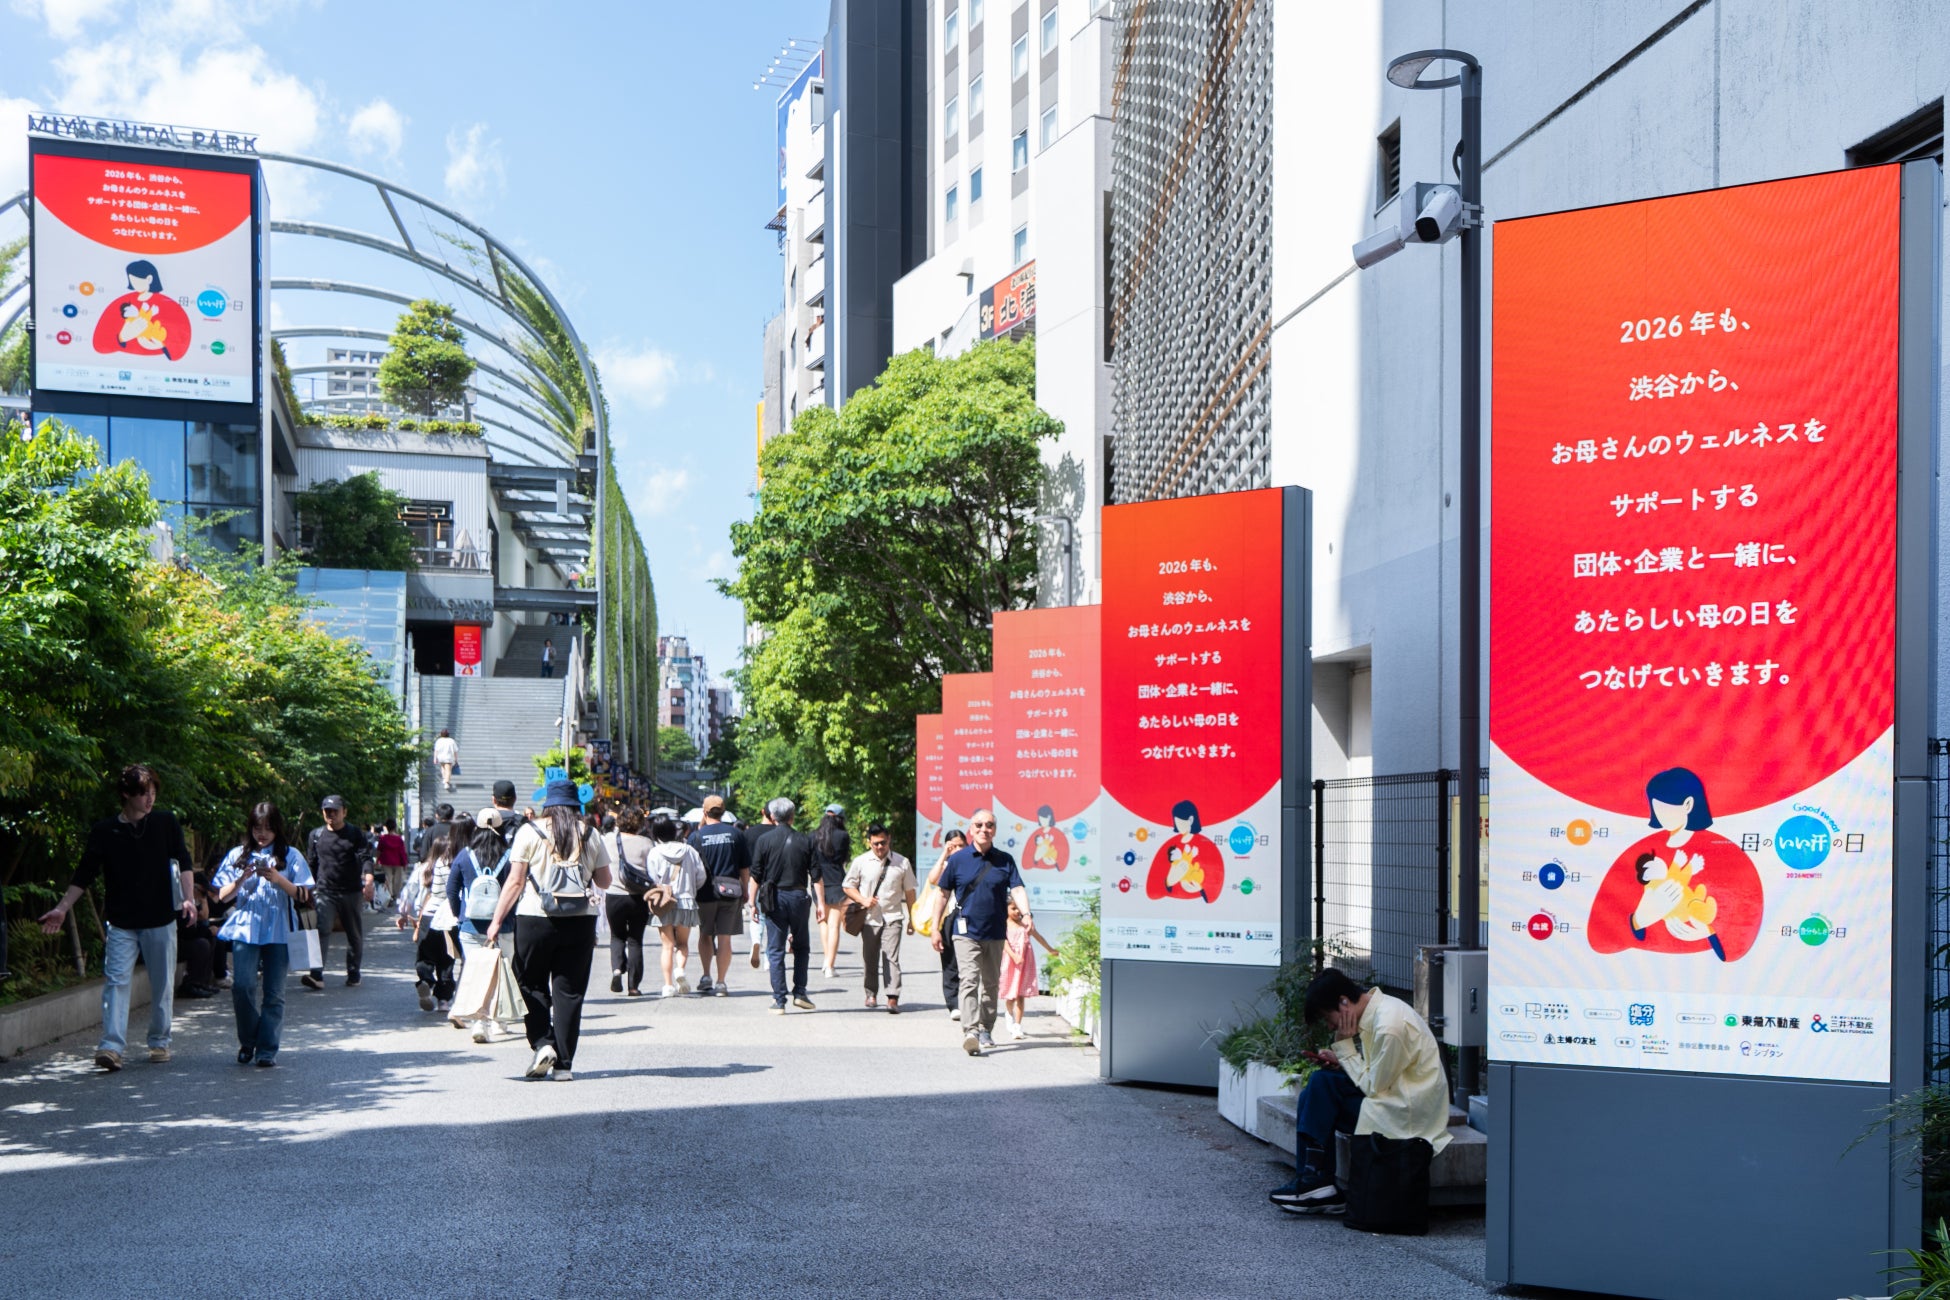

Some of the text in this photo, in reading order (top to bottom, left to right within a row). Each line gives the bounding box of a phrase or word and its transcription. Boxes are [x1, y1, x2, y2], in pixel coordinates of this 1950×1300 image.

[27, 113, 258, 154] MIYASHITA PARK
[105, 170, 125, 178] 2026
[102, 184, 186, 199] お母さんのウェルネスを
[110, 213, 179, 227] あたらしい母の日を
[112, 228, 177, 241] つなげていきます。
[981, 305, 994, 332] 3F
[1620, 315, 1683, 344] 2026
[1629, 369, 1739, 401] 渋谷から、
[1551, 418, 1827, 465] お母さんのウェルネスを
[1610, 484, 1759, 518] サポートする
[1158, 561, 1188, 575] 2026
[1573, 542, 1797, 578] 団体・企業と一緒に、
[1162, 590, 1213, 606] 渋谷から、
[452, 609, 493, 621] PARK
[1574, 600, 1798, 634] あたらしい母の日を
[1127, 618, 1251, 639] お母さんのウェルネスを
[1154, 651, 1222, 668] サポートする
[1579, 660, 1790, 690] つなげていきます。
[1138, 682, 1239, 699] 団体・企業と一緒に、
[1026, 707, 1068, 719] サポートする
[1138, 713, 1239, 730] あたらしい母の日を
[1140, 744, 1236, 760] つなげていきます。
[1792, 802, 1841, 833] Good sweat
[1741, 1015, 1800, 1029] 東急不動産
